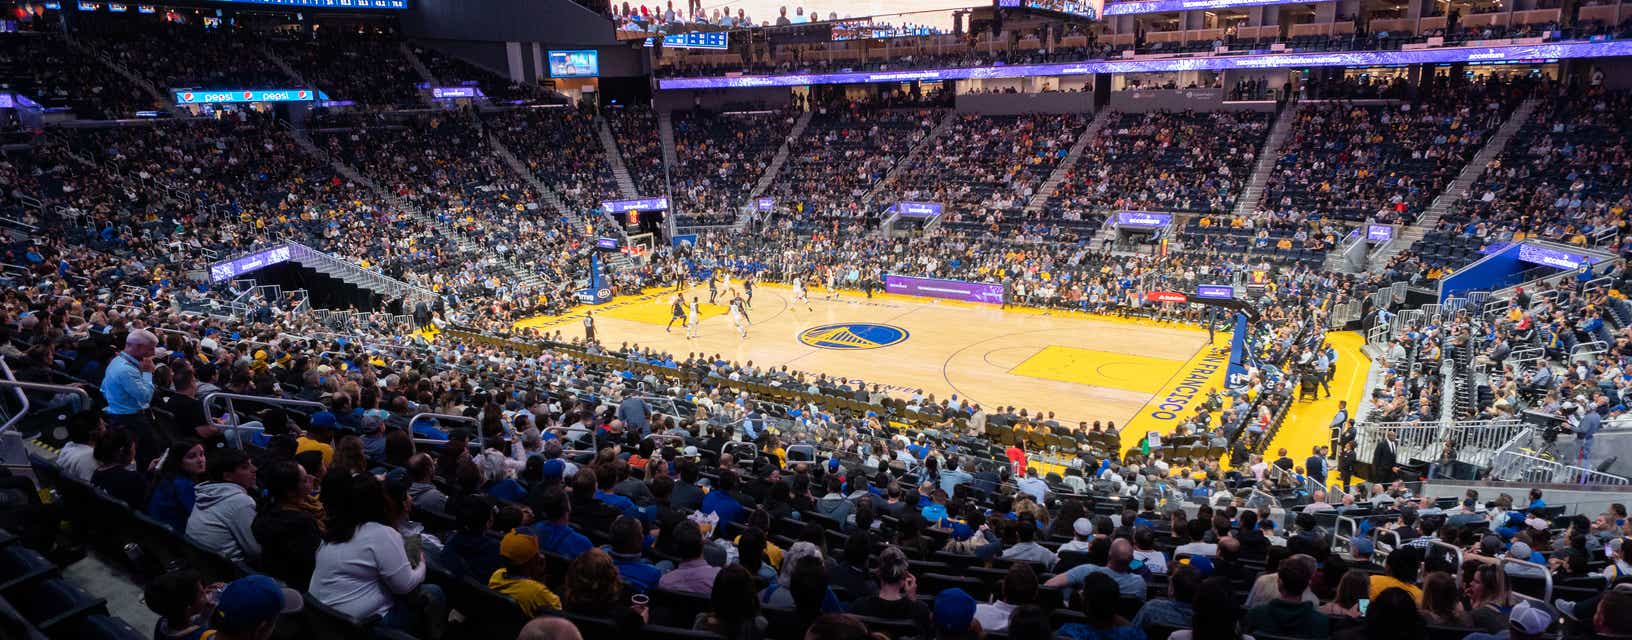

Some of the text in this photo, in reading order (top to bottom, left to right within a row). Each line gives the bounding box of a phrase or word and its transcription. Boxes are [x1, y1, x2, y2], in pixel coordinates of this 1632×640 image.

[204, 90, 289, 102] pepsi pepsi
[1152, 363, 1219, 420] FRANCISCO
